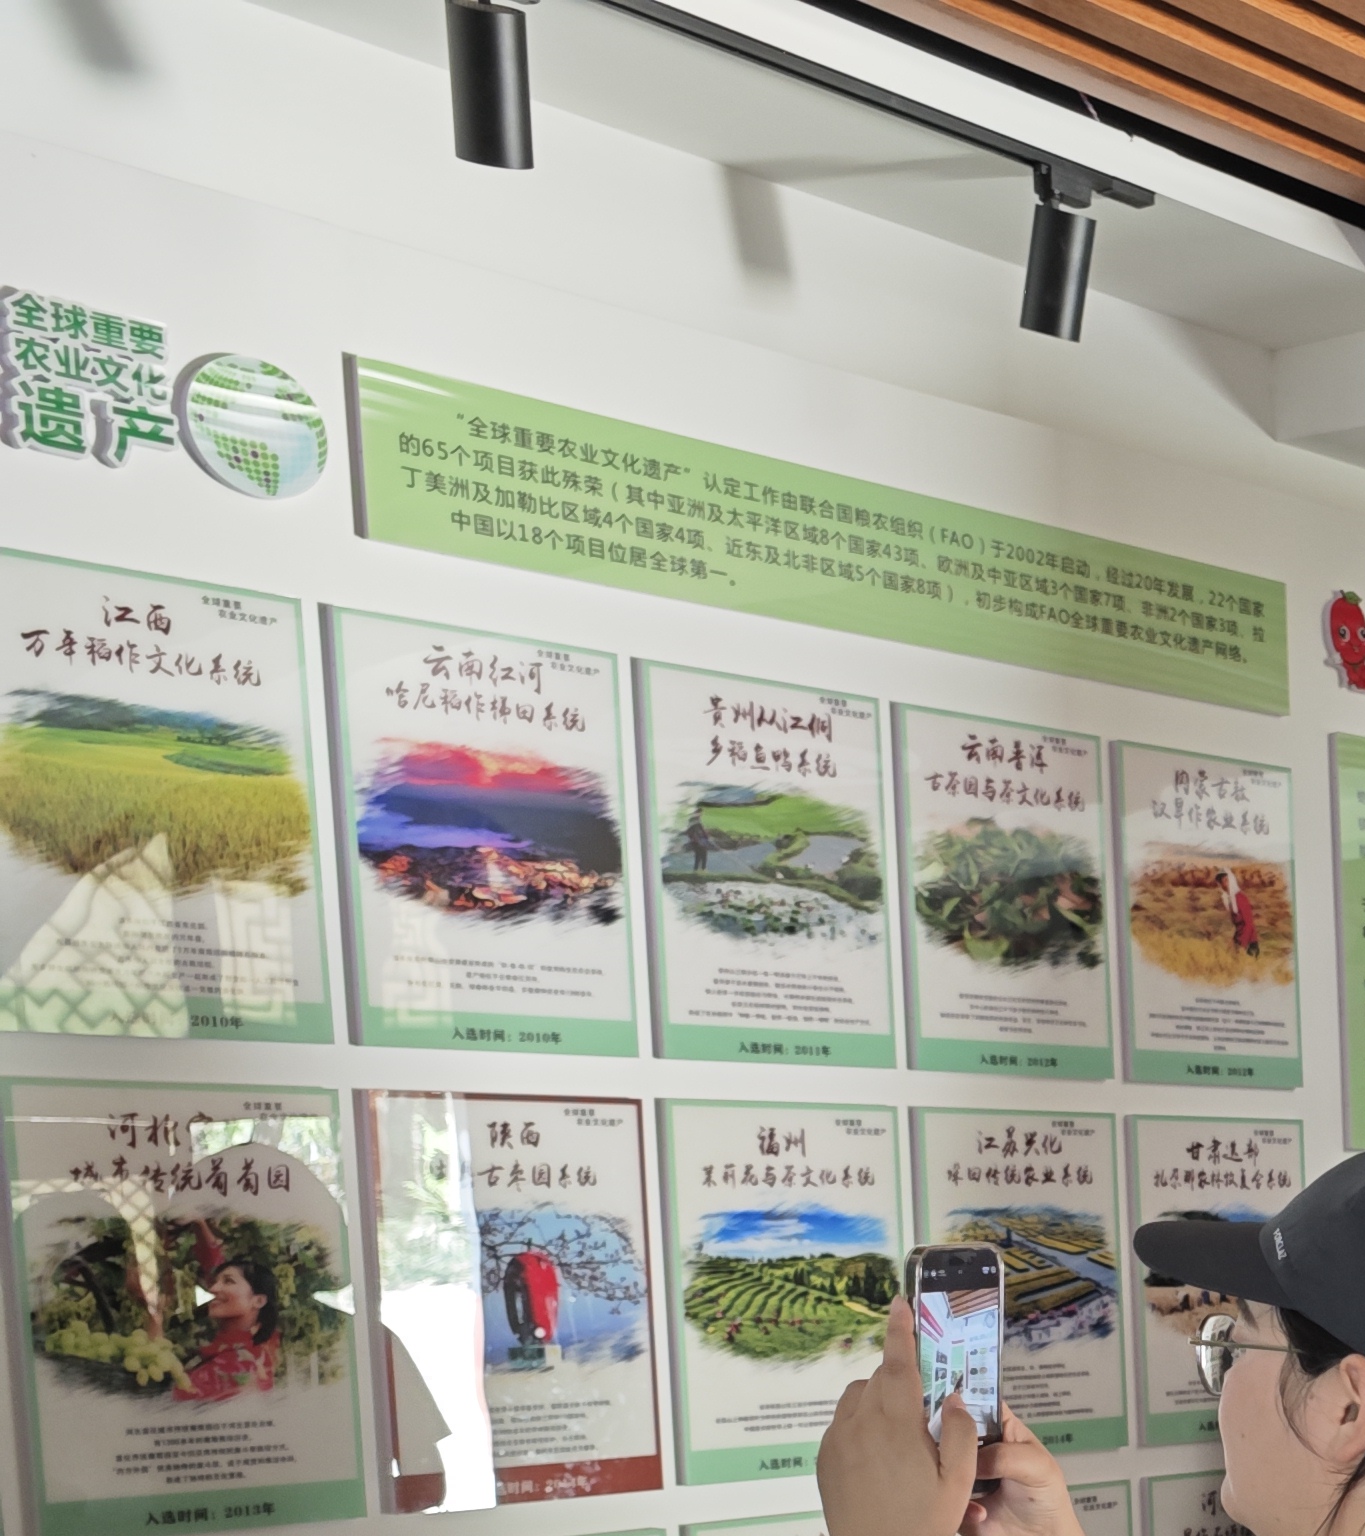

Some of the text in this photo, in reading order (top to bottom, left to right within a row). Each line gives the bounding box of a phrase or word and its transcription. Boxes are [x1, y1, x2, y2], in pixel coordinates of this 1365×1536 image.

[11, 294, 165, 359] 全球重要
[15, 337, 167, 403] 农业文化
[19, 387, 175, 459] 遗产
[452, 510, 735, 587] 中国以18个项目位居全球第一。
[103, 595, 172, 635] 江西
[201, 595, 242, 611] 全球重要
[21, 629, 261, 687] 万年稻作文化系统
[423, 645, 542, 695] 云南红河
[386, 682, 586, 733] 哈尼稻作梯田系统
[703, 694, 832, 743] 贵州从江侗
[706, 735, 837, 778] 乡稻鱼鸭系统
[961, 733, 1048, 774] 云南普洱
[487, 1120, 541, 1150] 陕西
[756, 1125, 807, 1157] 福州
[976, 1125, 1063, 1158] 江苏兴化
[1185, 1136, 1260, 1167] 甘肃迭部
[427, 1156, 598, 1192] 古枣园系统
[758, 1456, 818, 1472] 入选时间：
[145, 1501, 275, 1526] 入选时间：2013年
[1199, 1489, 1222, 1516] 河
